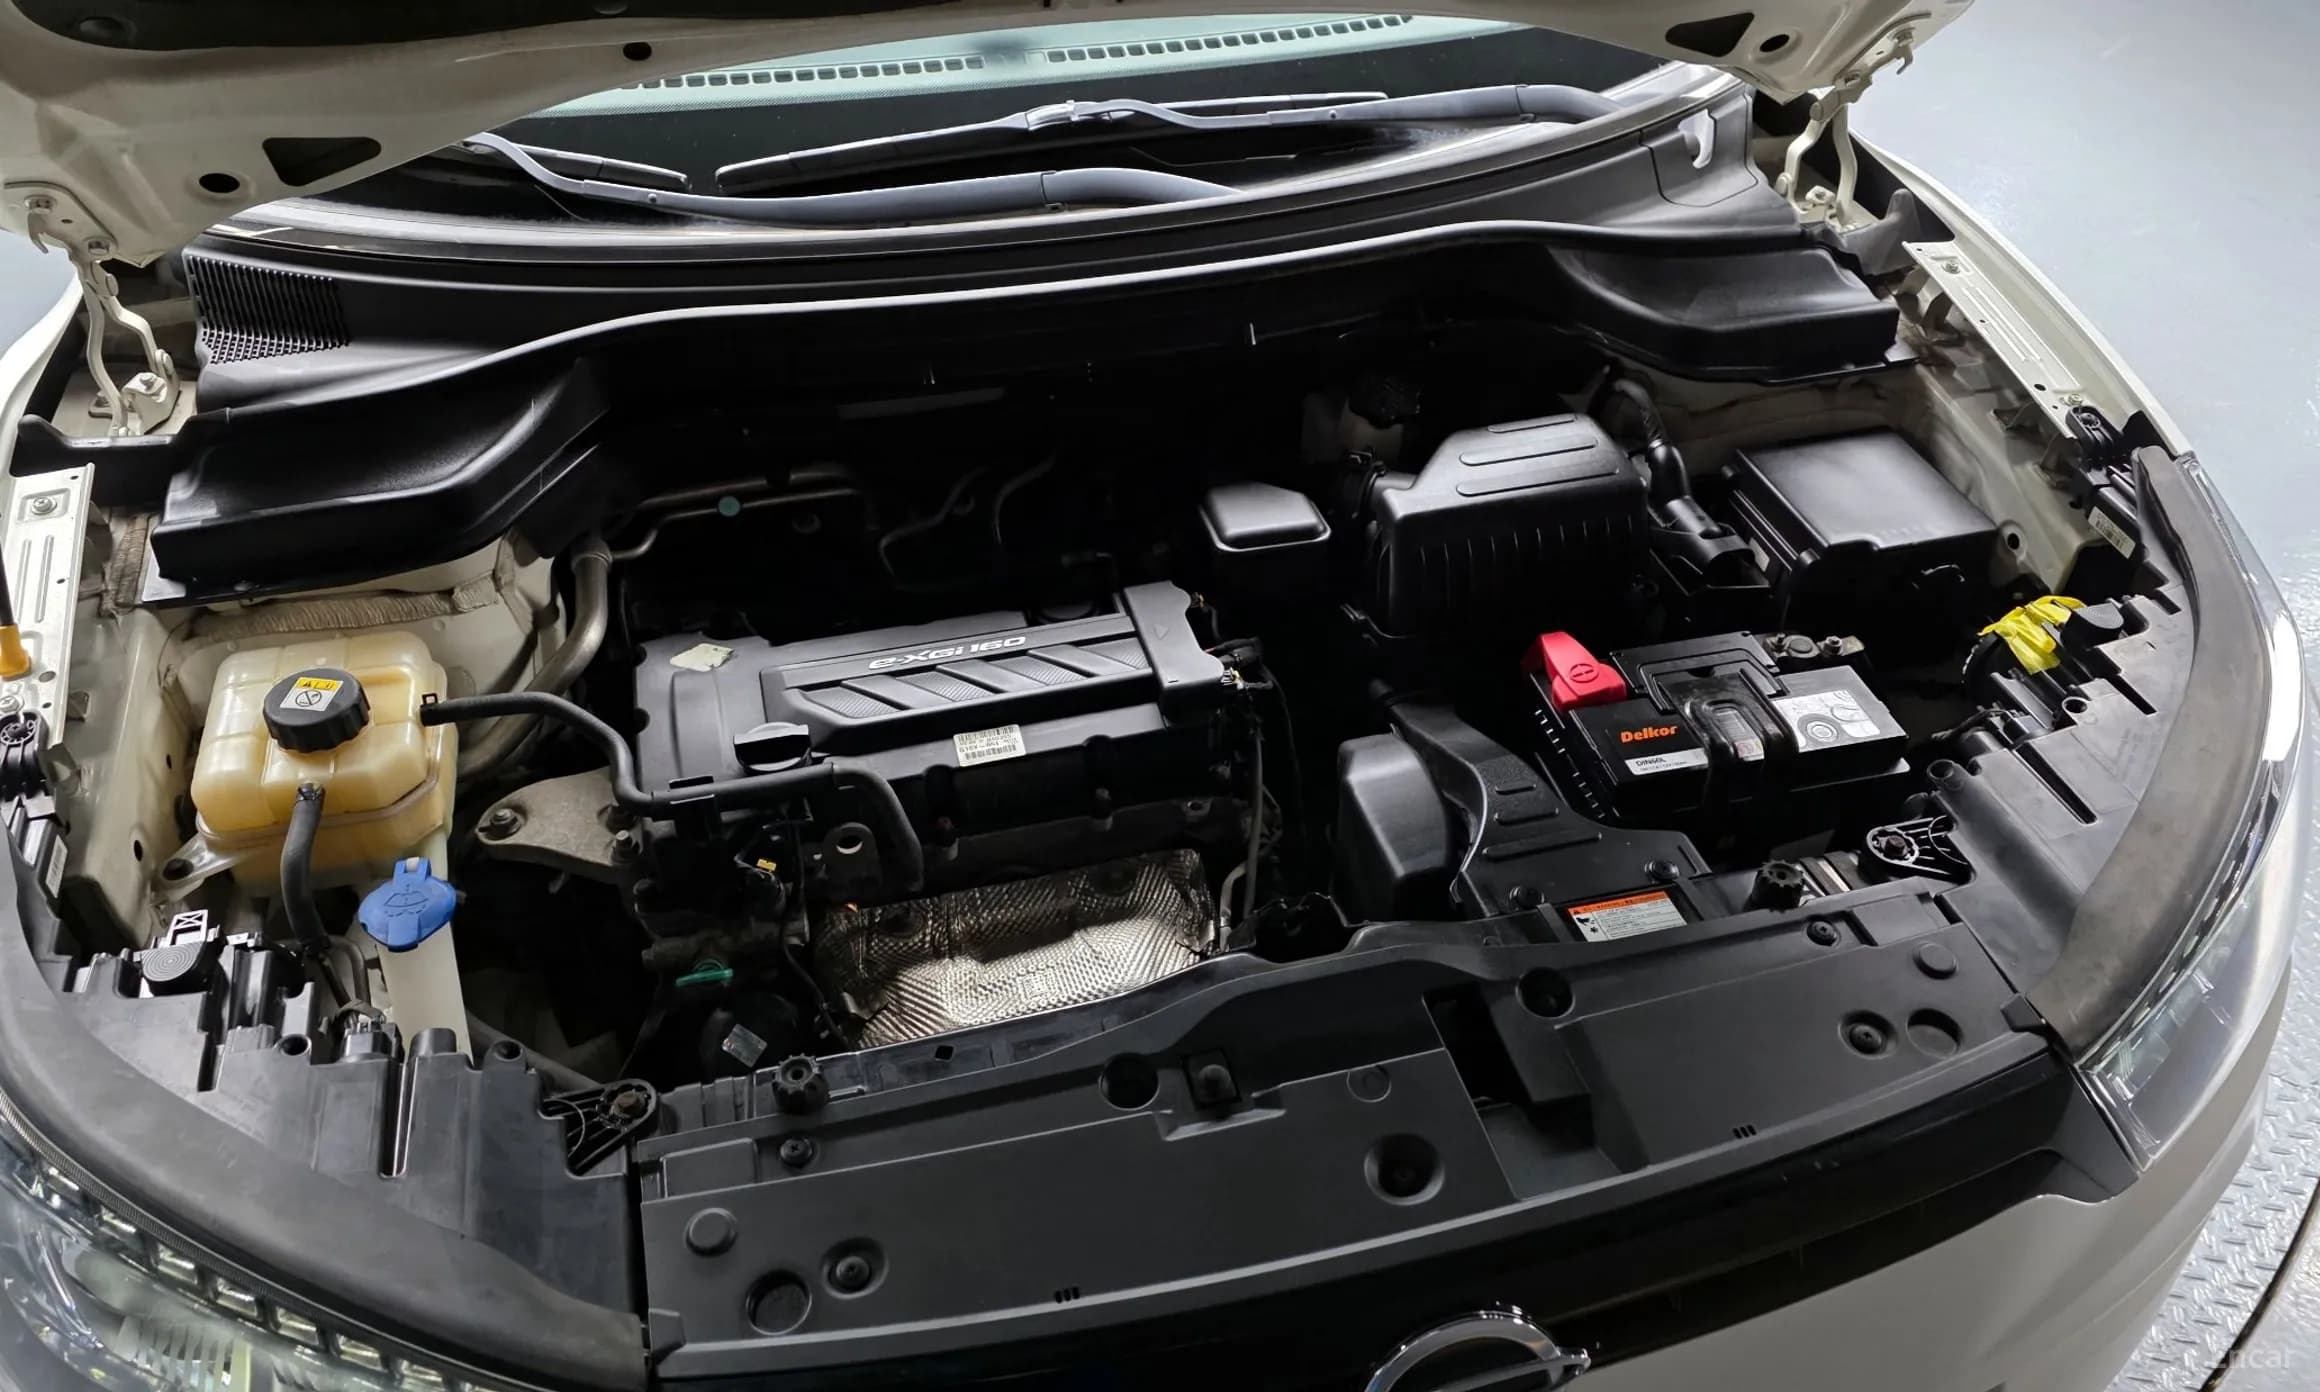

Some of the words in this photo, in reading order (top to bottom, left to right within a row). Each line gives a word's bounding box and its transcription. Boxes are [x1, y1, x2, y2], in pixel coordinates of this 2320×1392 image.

[868, 646, 963, 669] e-XGi
[970, 636, 1026, 652] 160
[1620, 725, 1678, 743] Delkor
